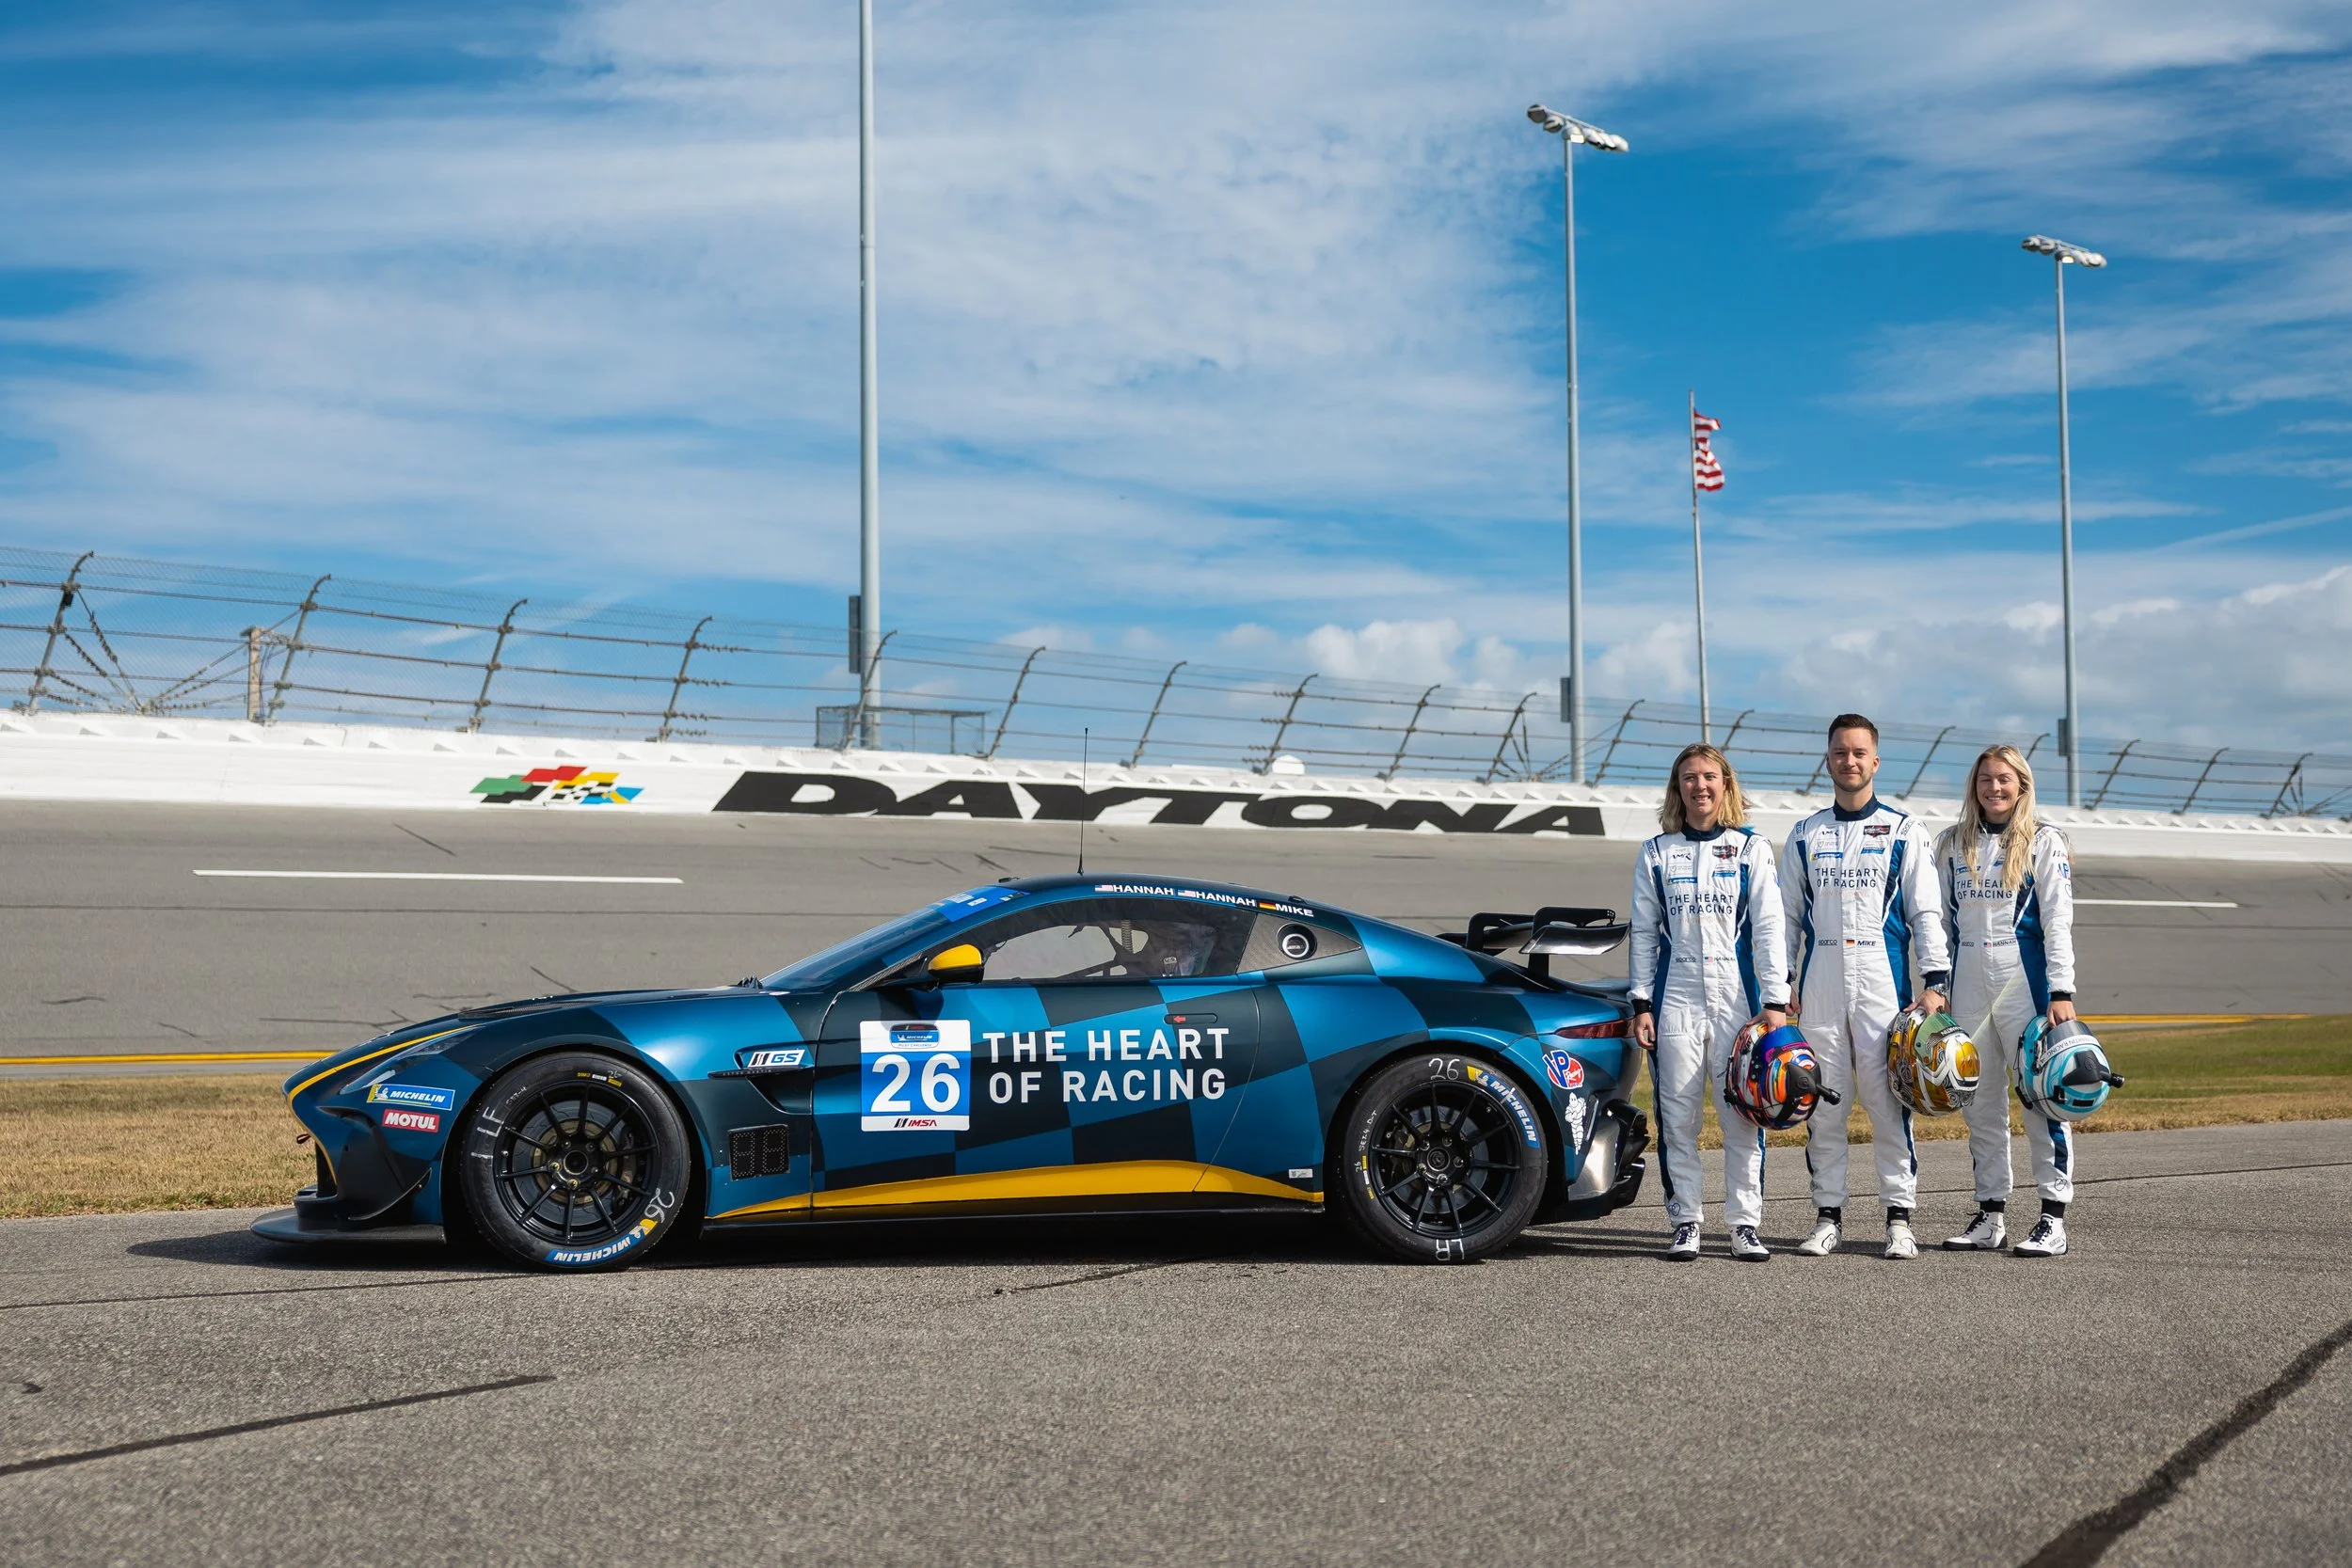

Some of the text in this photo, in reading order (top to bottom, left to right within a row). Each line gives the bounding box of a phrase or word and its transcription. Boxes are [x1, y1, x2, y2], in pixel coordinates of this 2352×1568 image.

[712, 770, 1605, 837] DAYTONA
[1815, 867, 1879, 878] THE HEART
[1113, 884, 1174, 895] HANNAH
[1817, 879, 1877, 888] OF RACING
[1956, 879, 1972, 889] THE
[1196, 891, 1257, 907] HANNAH
[1669, 894, 1734, 906] THE HEART
[1957, 890, 2012, 900] OF RACING
[1276, 904, 1314, 917] MIKE
[1670, 905, 1733, 916] OF RACING
[982, 1028, 1230, 1064] THE HEART
[2046, 1041, 2069, 1056] RACING
[771, 1053, 800, 1064] GS
[1429, 1057, 1460, 1081] 26
[1543, 1050, 1570, 1088] VP
[870, 1053, 961, 1113] 26
[989, 1068, 1226, 1104] OF RACING
[389, 1090, 446, 1103] MICHELIN
[1489, 1081, 1537, 1143] MICHELIN
[384, 1112, 437, 1130] MOTUL
[477, 1106, 505, 1138] LF
[644, 1187, 675, 1224] 26
[553, 1236, 631, 1262] MICHELIN
